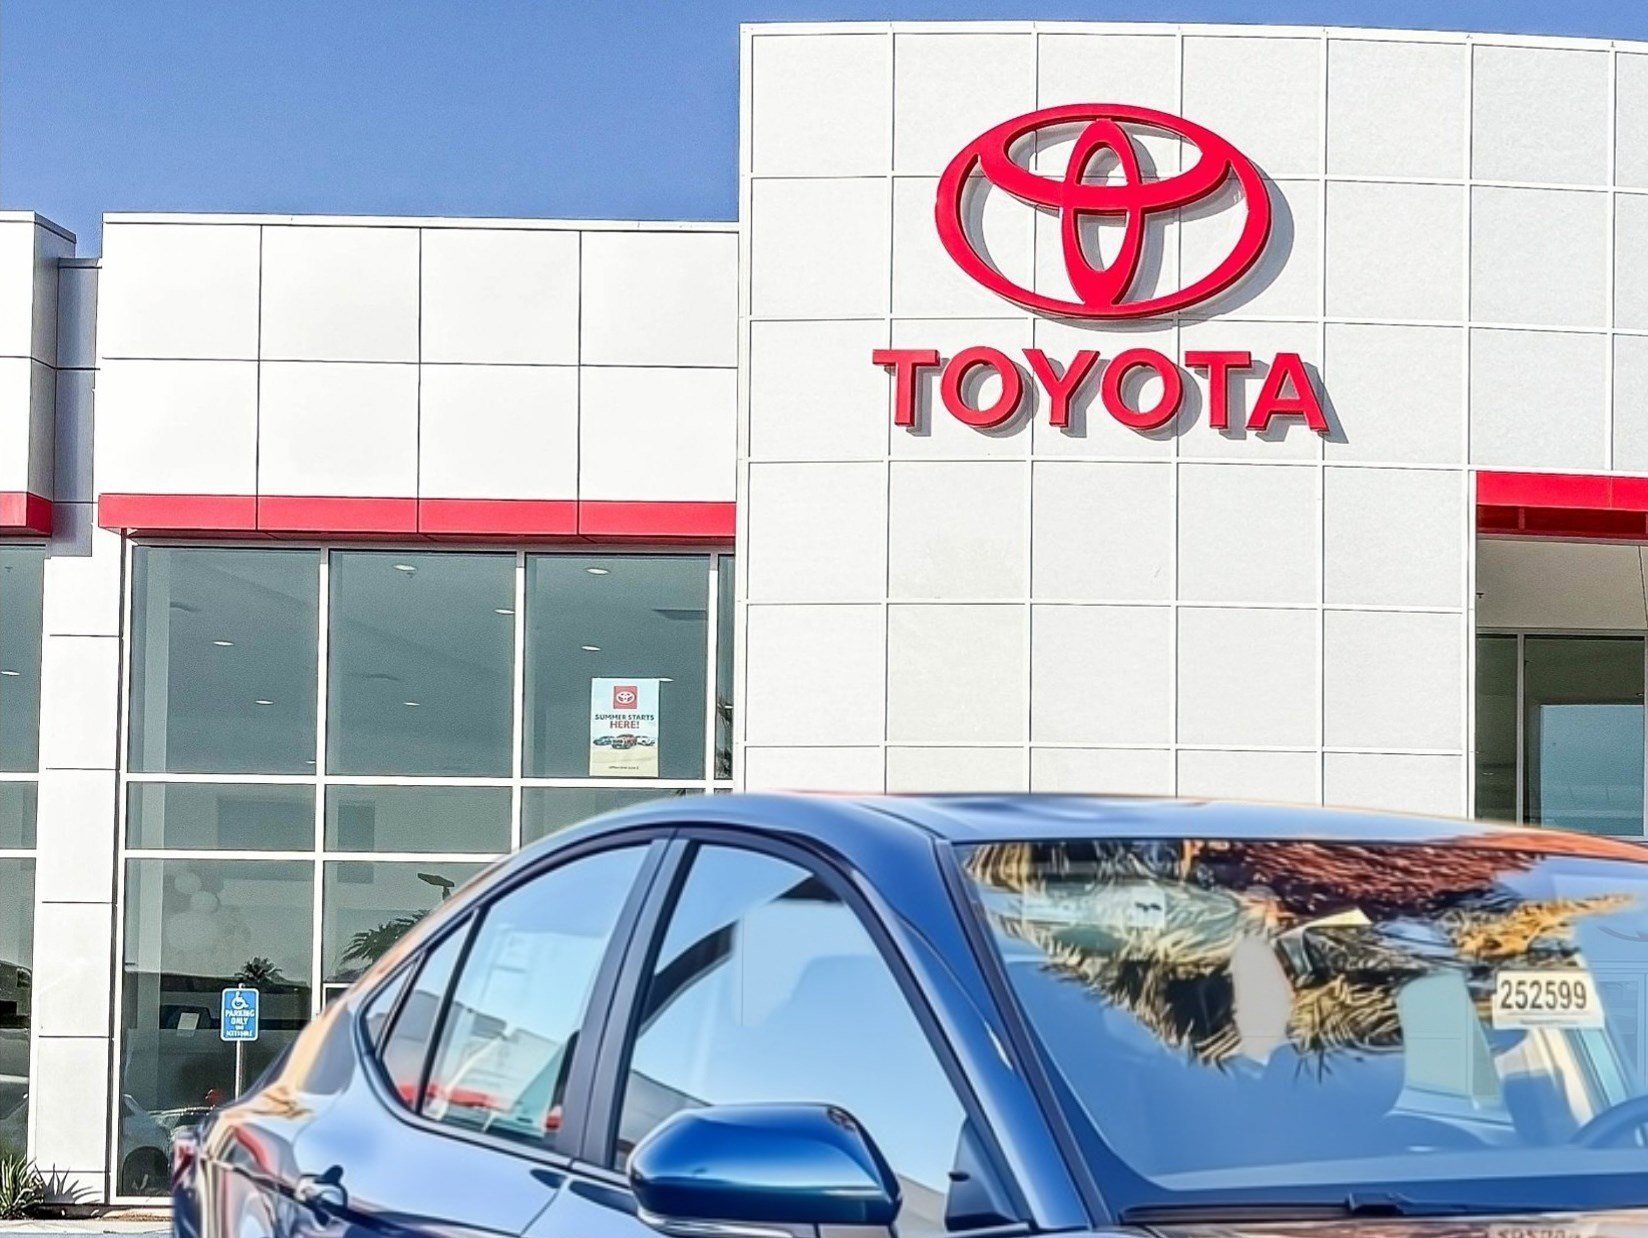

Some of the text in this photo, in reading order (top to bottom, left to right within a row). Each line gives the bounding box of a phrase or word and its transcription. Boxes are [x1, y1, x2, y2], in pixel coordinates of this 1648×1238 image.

[872, 346, 1330, 432] TOYOTA
[609, 720, 640, 729] HERE!
[1500, 979, 1588, 1010] 252599
[225, 1009, 255, 1018] PARKING
[230, 1017, 249, 1025] ONLY
